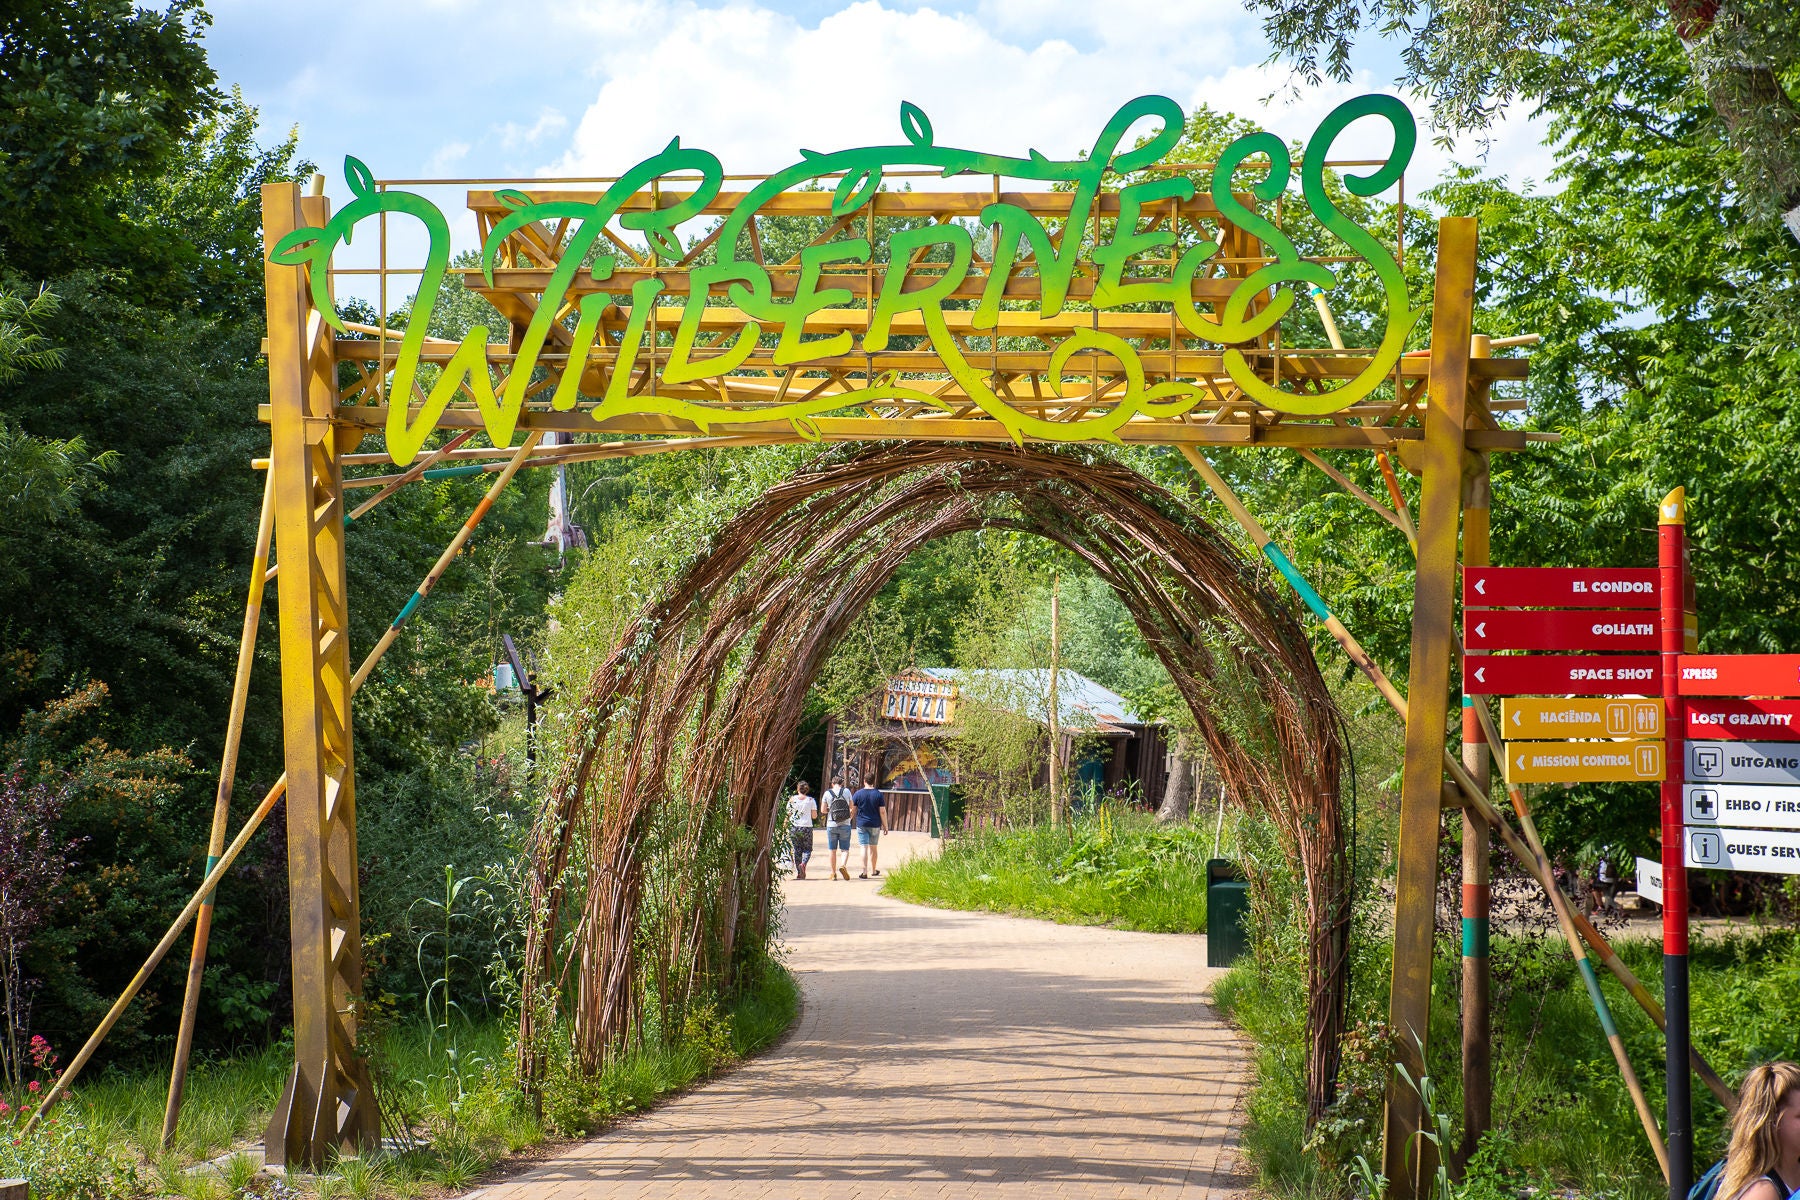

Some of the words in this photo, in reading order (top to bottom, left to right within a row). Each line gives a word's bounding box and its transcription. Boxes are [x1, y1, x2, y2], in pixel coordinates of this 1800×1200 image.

[1572, 581, 1588, 593] EL
[1591, 581, 1654, 593] CONDOR
[1569, 668, 1614, 680] SPACE
[1616, 668, 1654, 680] SHOT
[1682, 668, 1718, 680] XPRESS
[887, 694, 945, 719] PIZZA
[1691, 712, 1726, 725] LOST
[1582, 754, 1632, 767] CONTROL
[1725, 799, 1761, 811] EHBO
[1726, 844, 1767, 856] GUEST
